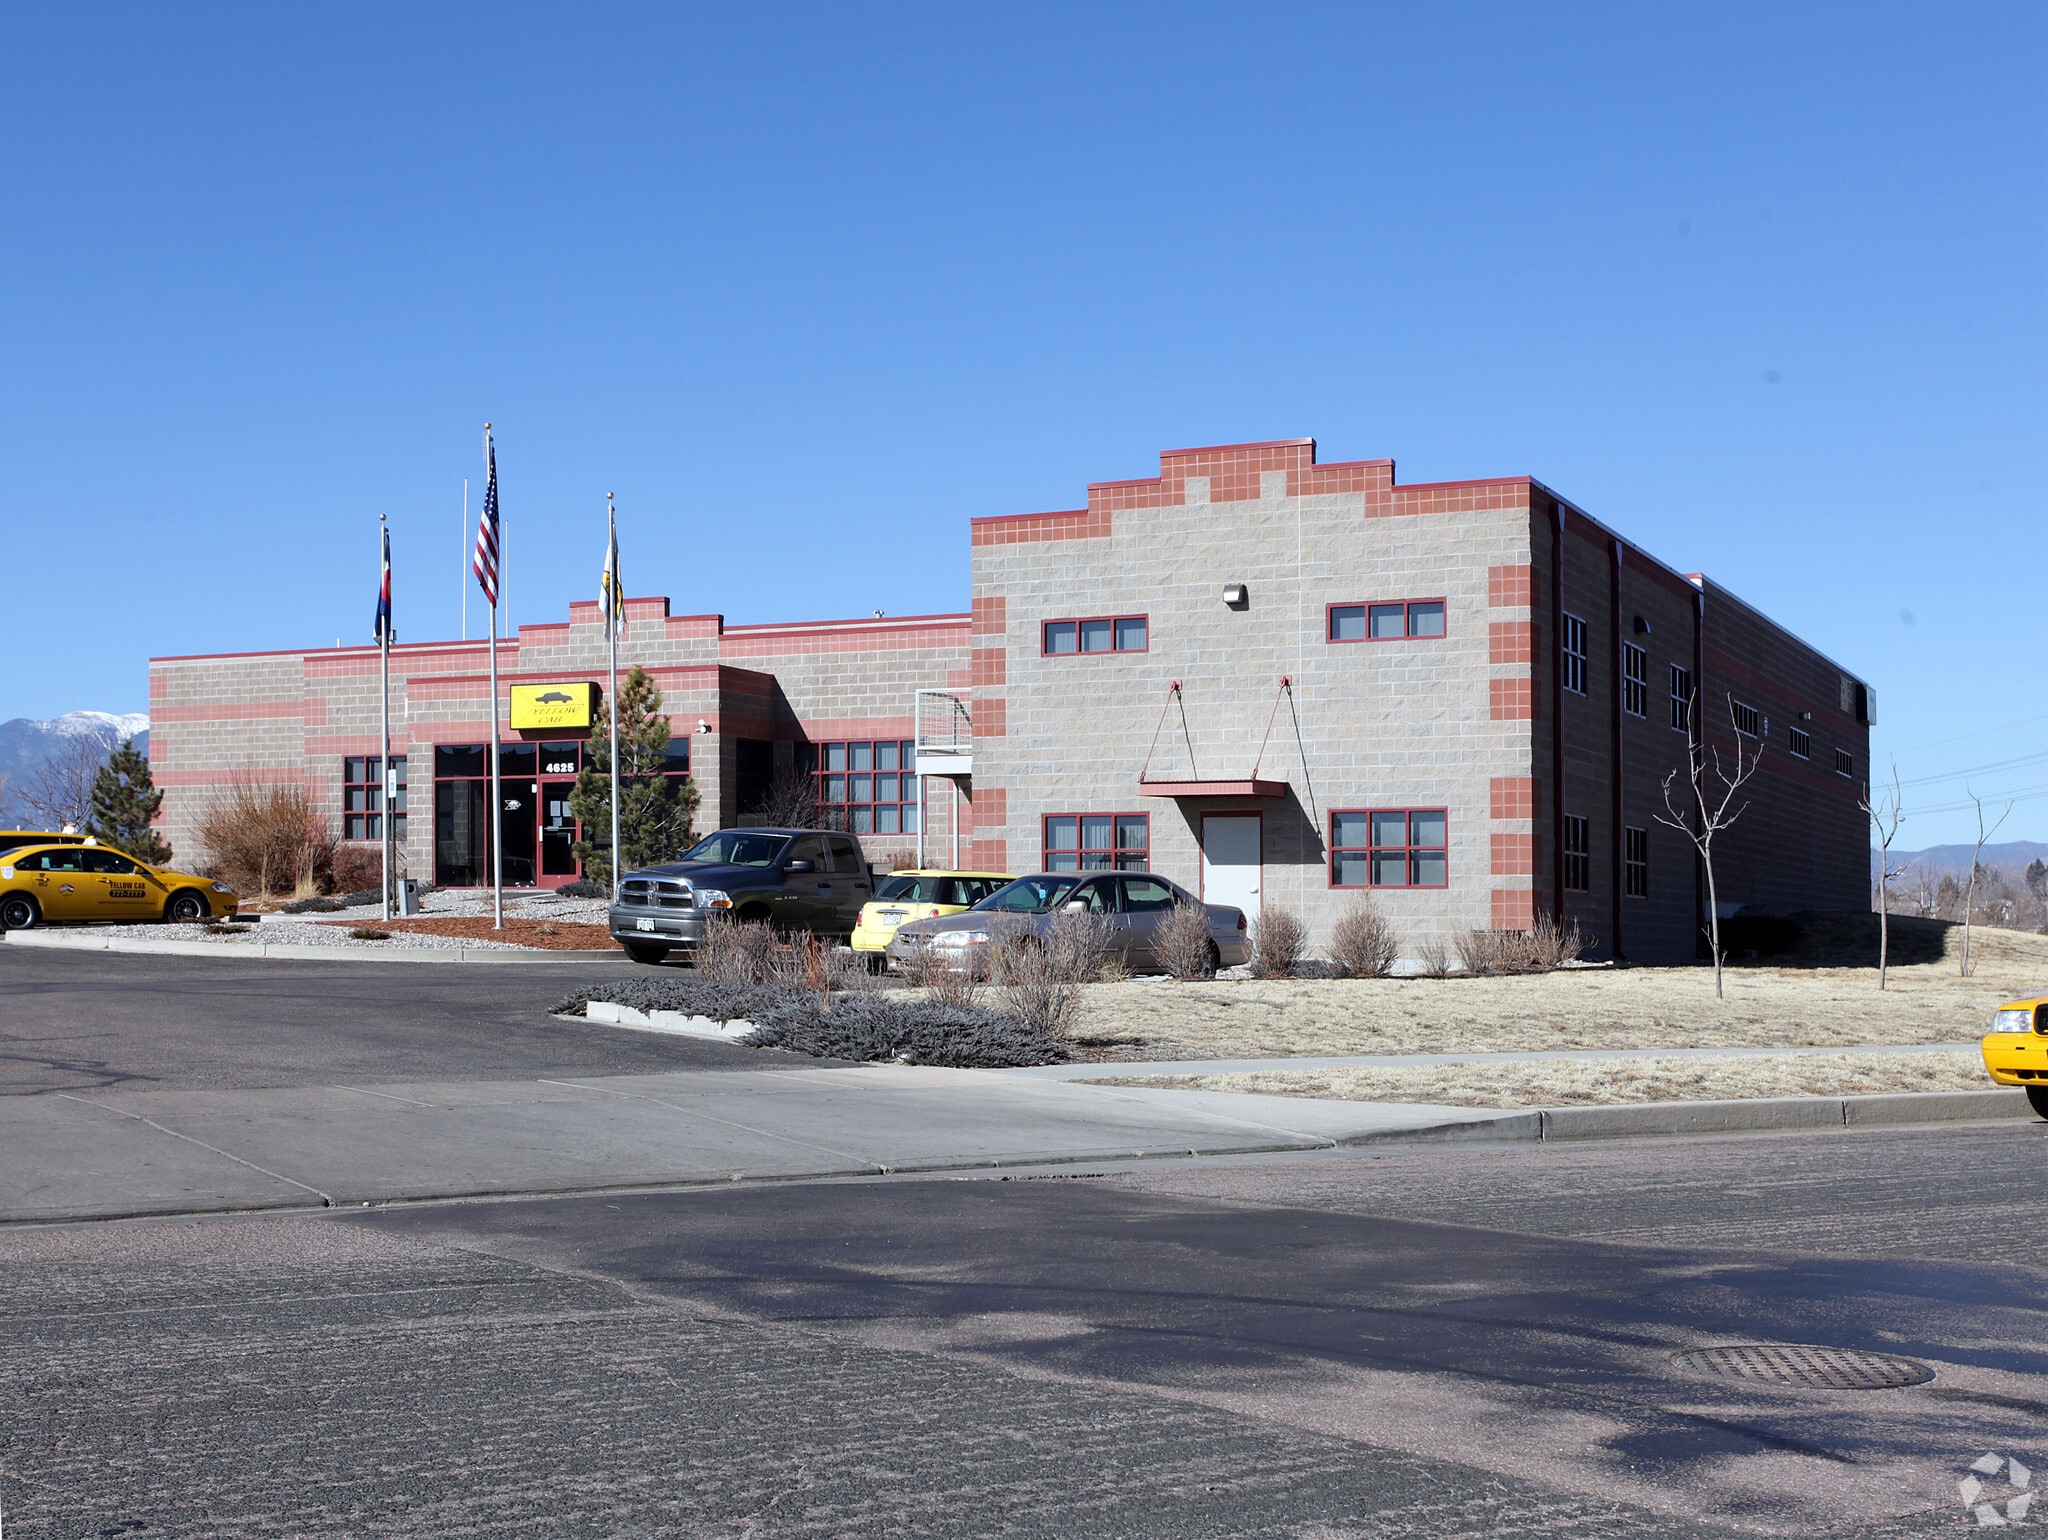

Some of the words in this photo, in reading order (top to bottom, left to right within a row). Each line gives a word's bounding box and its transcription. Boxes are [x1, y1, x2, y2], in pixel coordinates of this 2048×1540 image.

[533, 706, 580, 715] YELLOW
[537, 716, 563, 724] CAB
[545, 762, 575, 774] 4625
